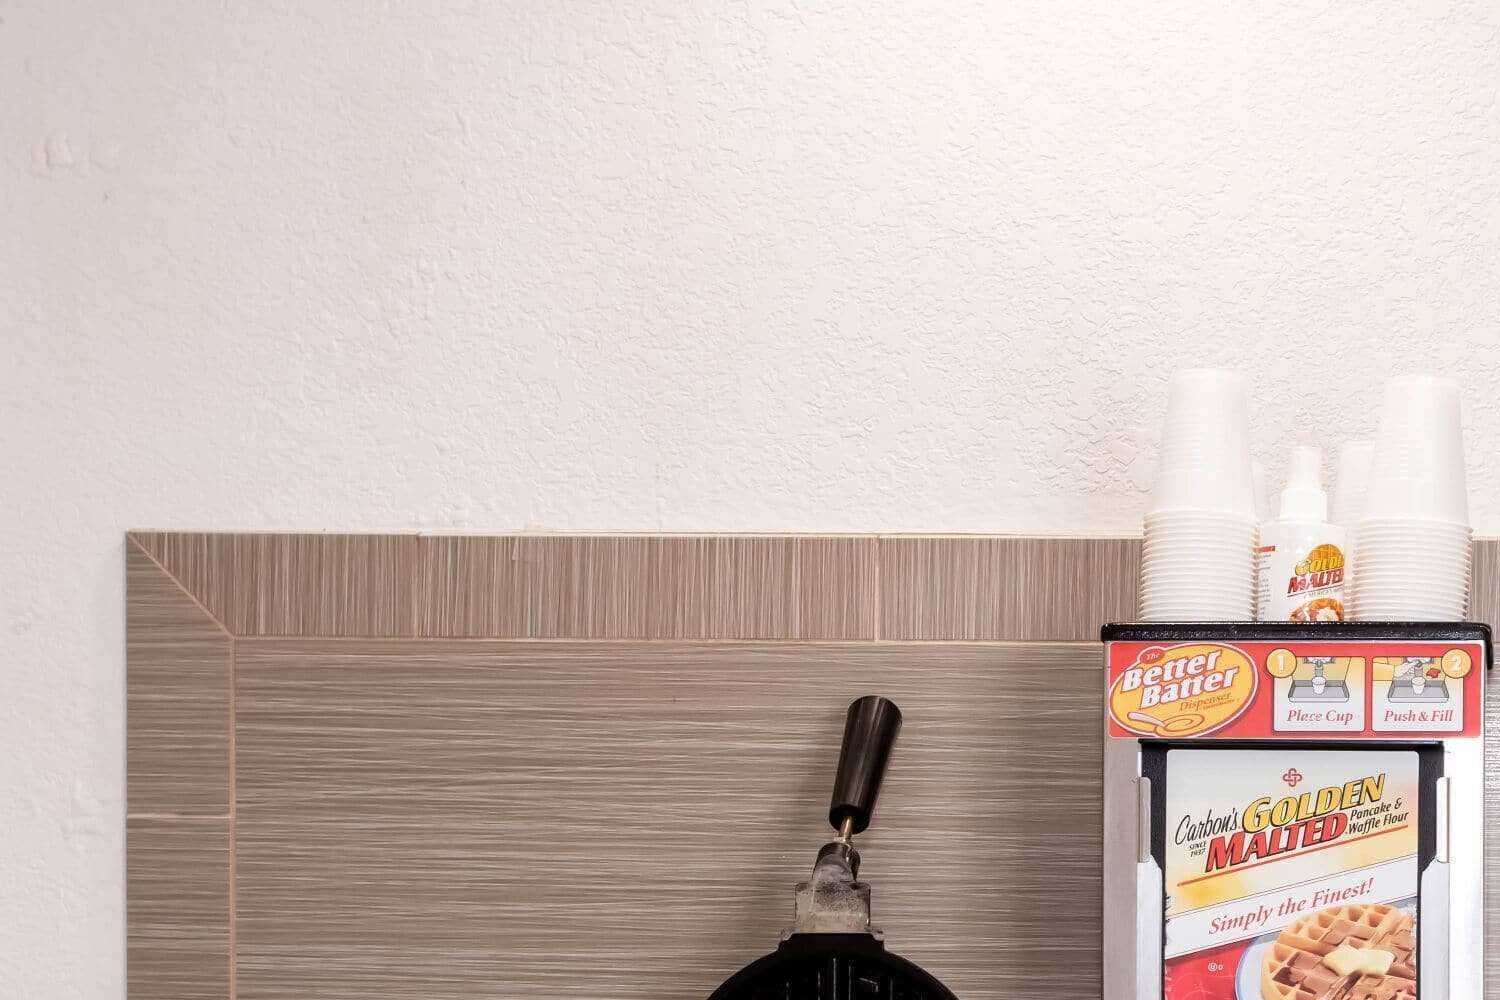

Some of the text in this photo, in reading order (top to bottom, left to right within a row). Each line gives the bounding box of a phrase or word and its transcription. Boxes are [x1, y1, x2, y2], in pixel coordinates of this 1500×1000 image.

[1120, 649, 1222, 694] Better
[1139, 666, 1239, 710] Batter
[1179, 693, 1231, 712] Dispenser
[1326, 710, 1353, 725] Cup
[1384, 710, 1453, 722] Push & Fill
[1175, 773, 1385, 845] Carbon's GOLDEN
[1349, 811, 1409, 835] Waffle Flour
[1350, 797, 1403, 821] Pancake &
[1205, 812, 1348, 873] MALTED
[1208, 877, 1374, 935] Simply the Finest!
